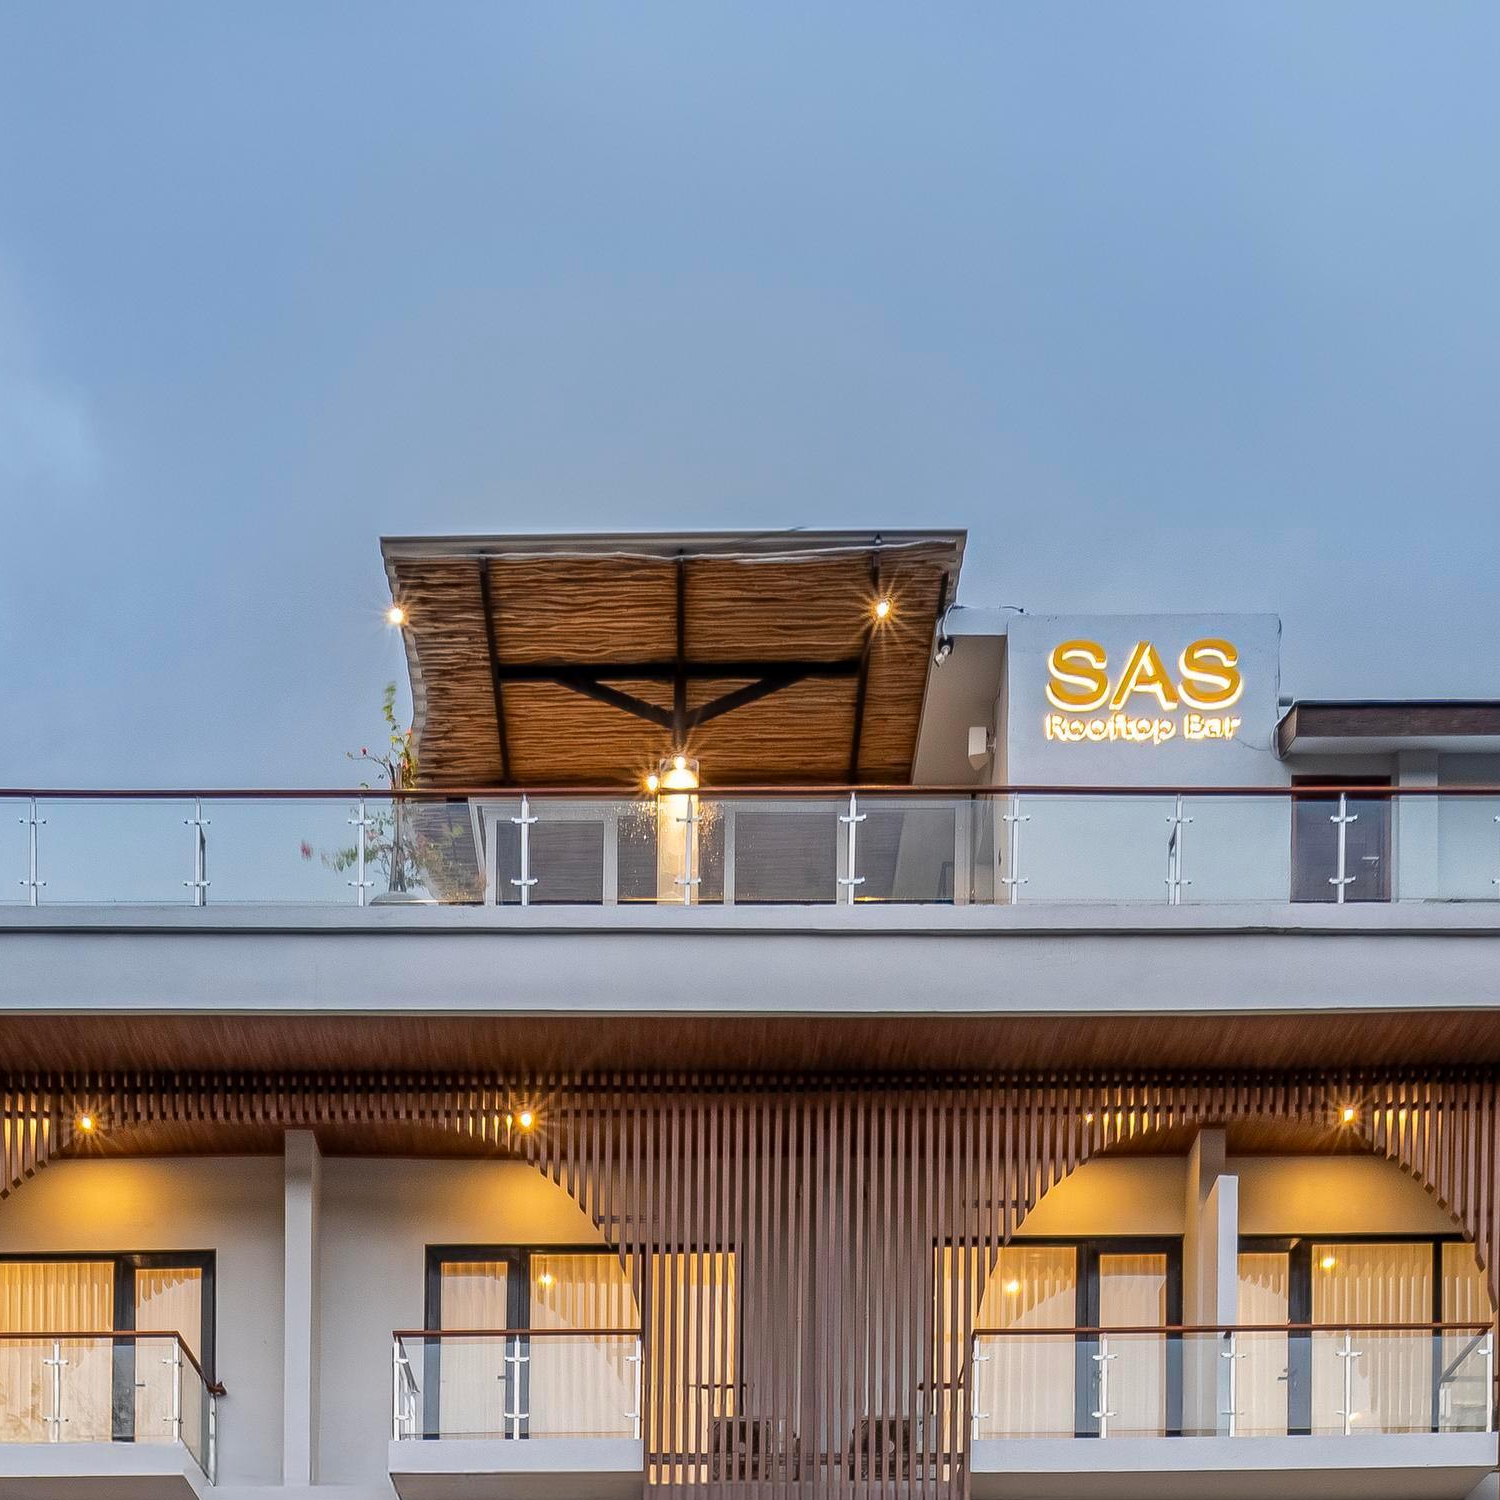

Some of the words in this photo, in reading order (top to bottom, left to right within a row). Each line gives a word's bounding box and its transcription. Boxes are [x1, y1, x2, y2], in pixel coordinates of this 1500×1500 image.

[1046, 638, 1243, 712] SAS
[1045, 712, 1176, 745] Rooftop
[1184, 713, 1241, 740] Bar
